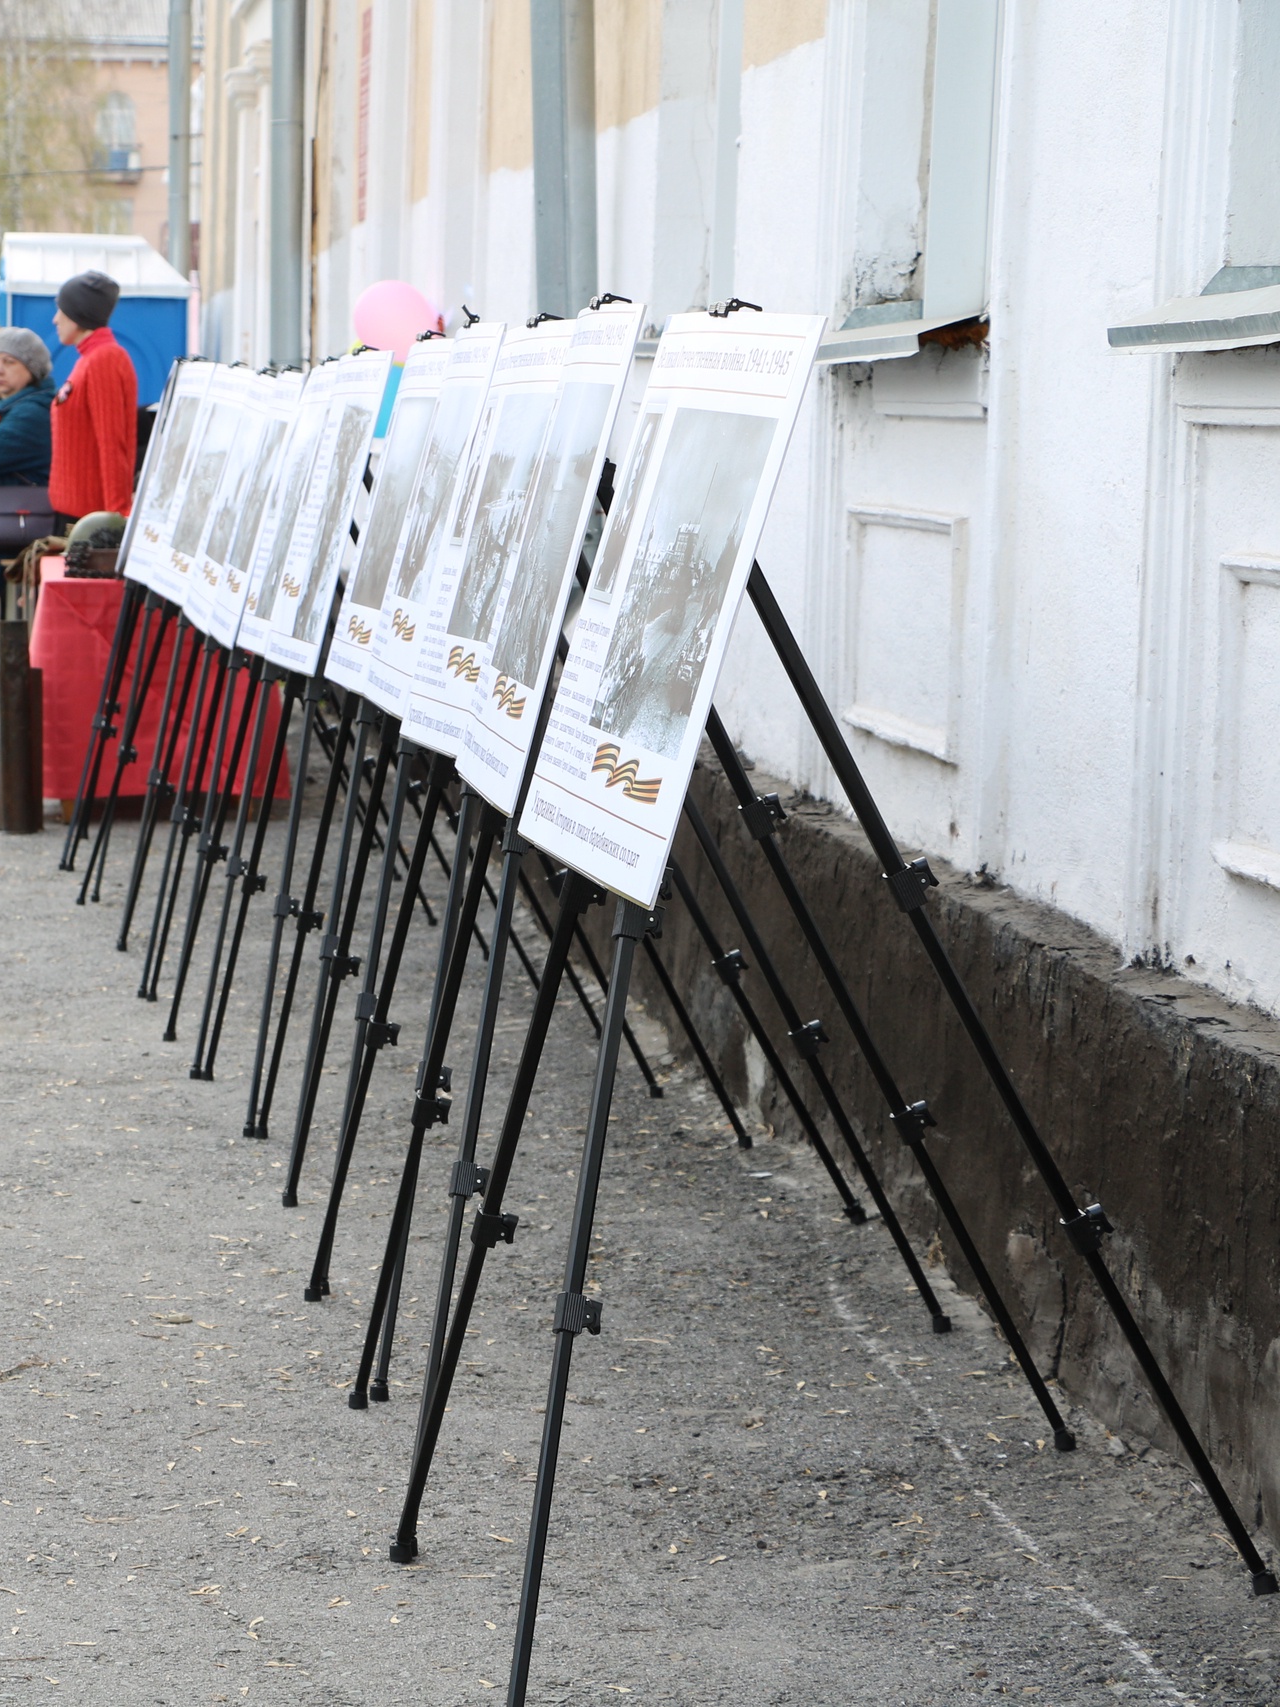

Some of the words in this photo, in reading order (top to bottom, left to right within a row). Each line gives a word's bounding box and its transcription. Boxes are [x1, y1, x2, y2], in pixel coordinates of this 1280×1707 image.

[719, 345, 747, 372] война
[744, 347, 794, 376] 1941-1945
[618, 846, 640, 870] солдат
